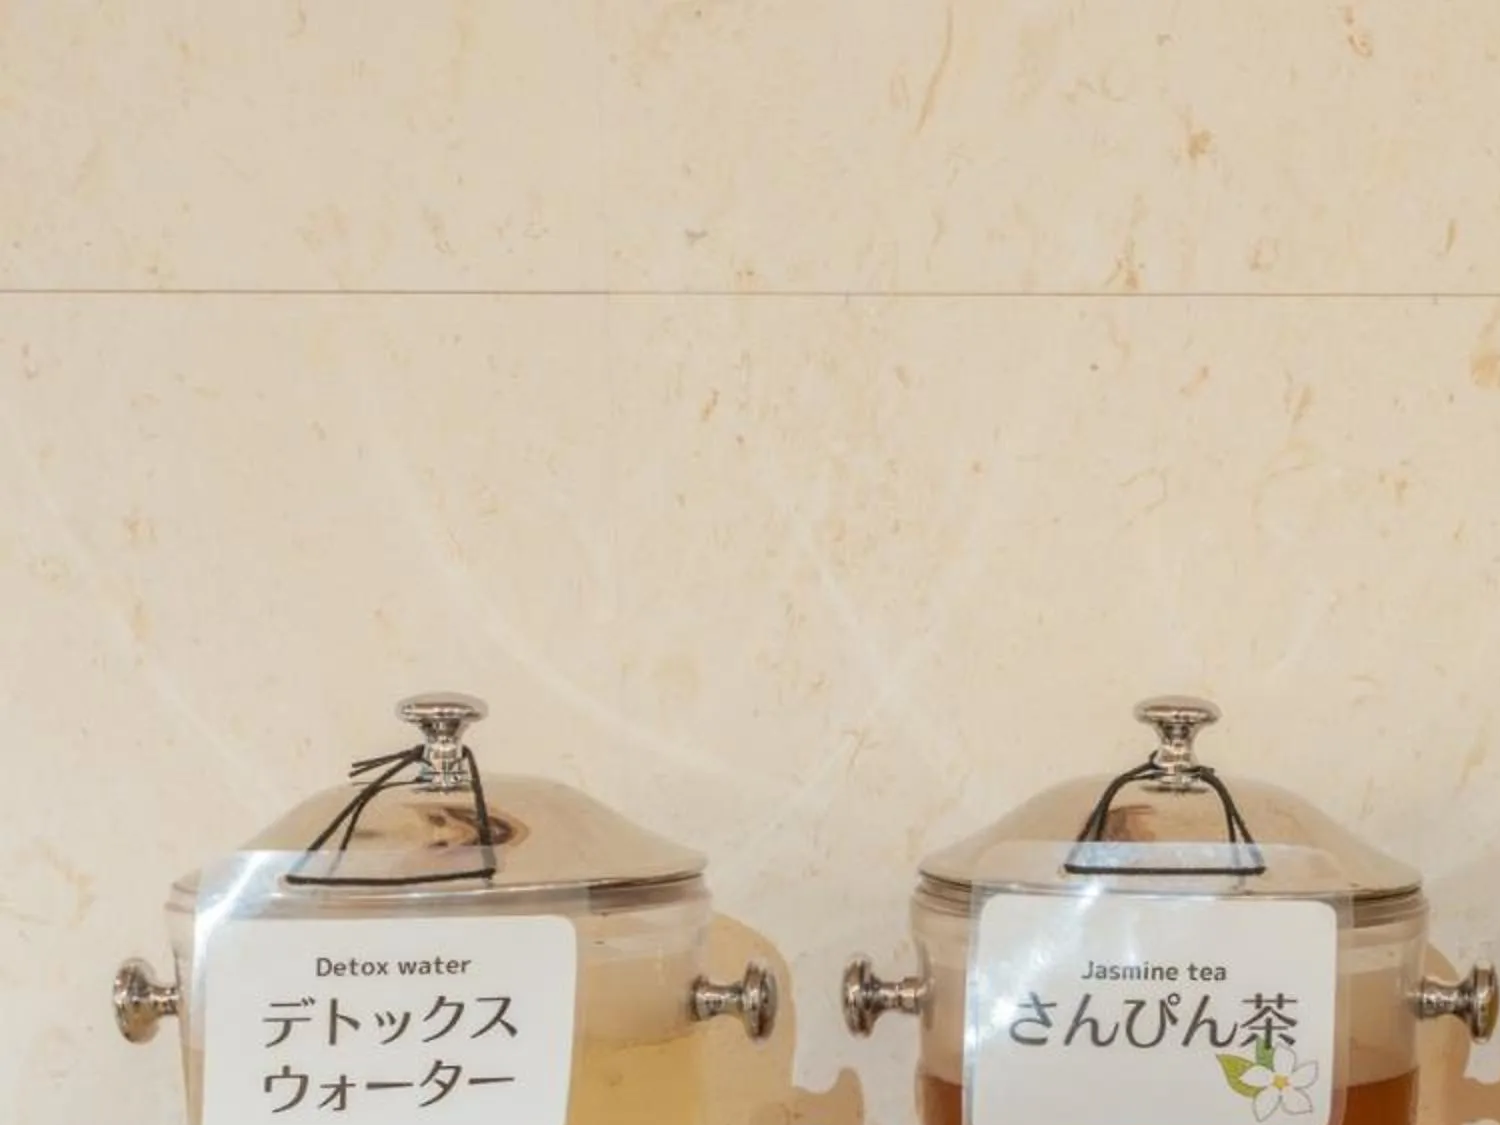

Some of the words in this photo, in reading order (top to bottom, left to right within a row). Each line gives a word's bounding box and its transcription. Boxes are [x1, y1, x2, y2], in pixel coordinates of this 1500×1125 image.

[315, 957, 389, 977] Detox
[398, 956, 472, 976] water
[1081, 960, 1178, 982] Jasmine
[1188, 962, 1227, 982] tea
[262, 995, 518, 1048] デトックス
[1009, 991, 1298, 1049] さんぴん茶
[263, 1059, 515, 1114] ウォーター
